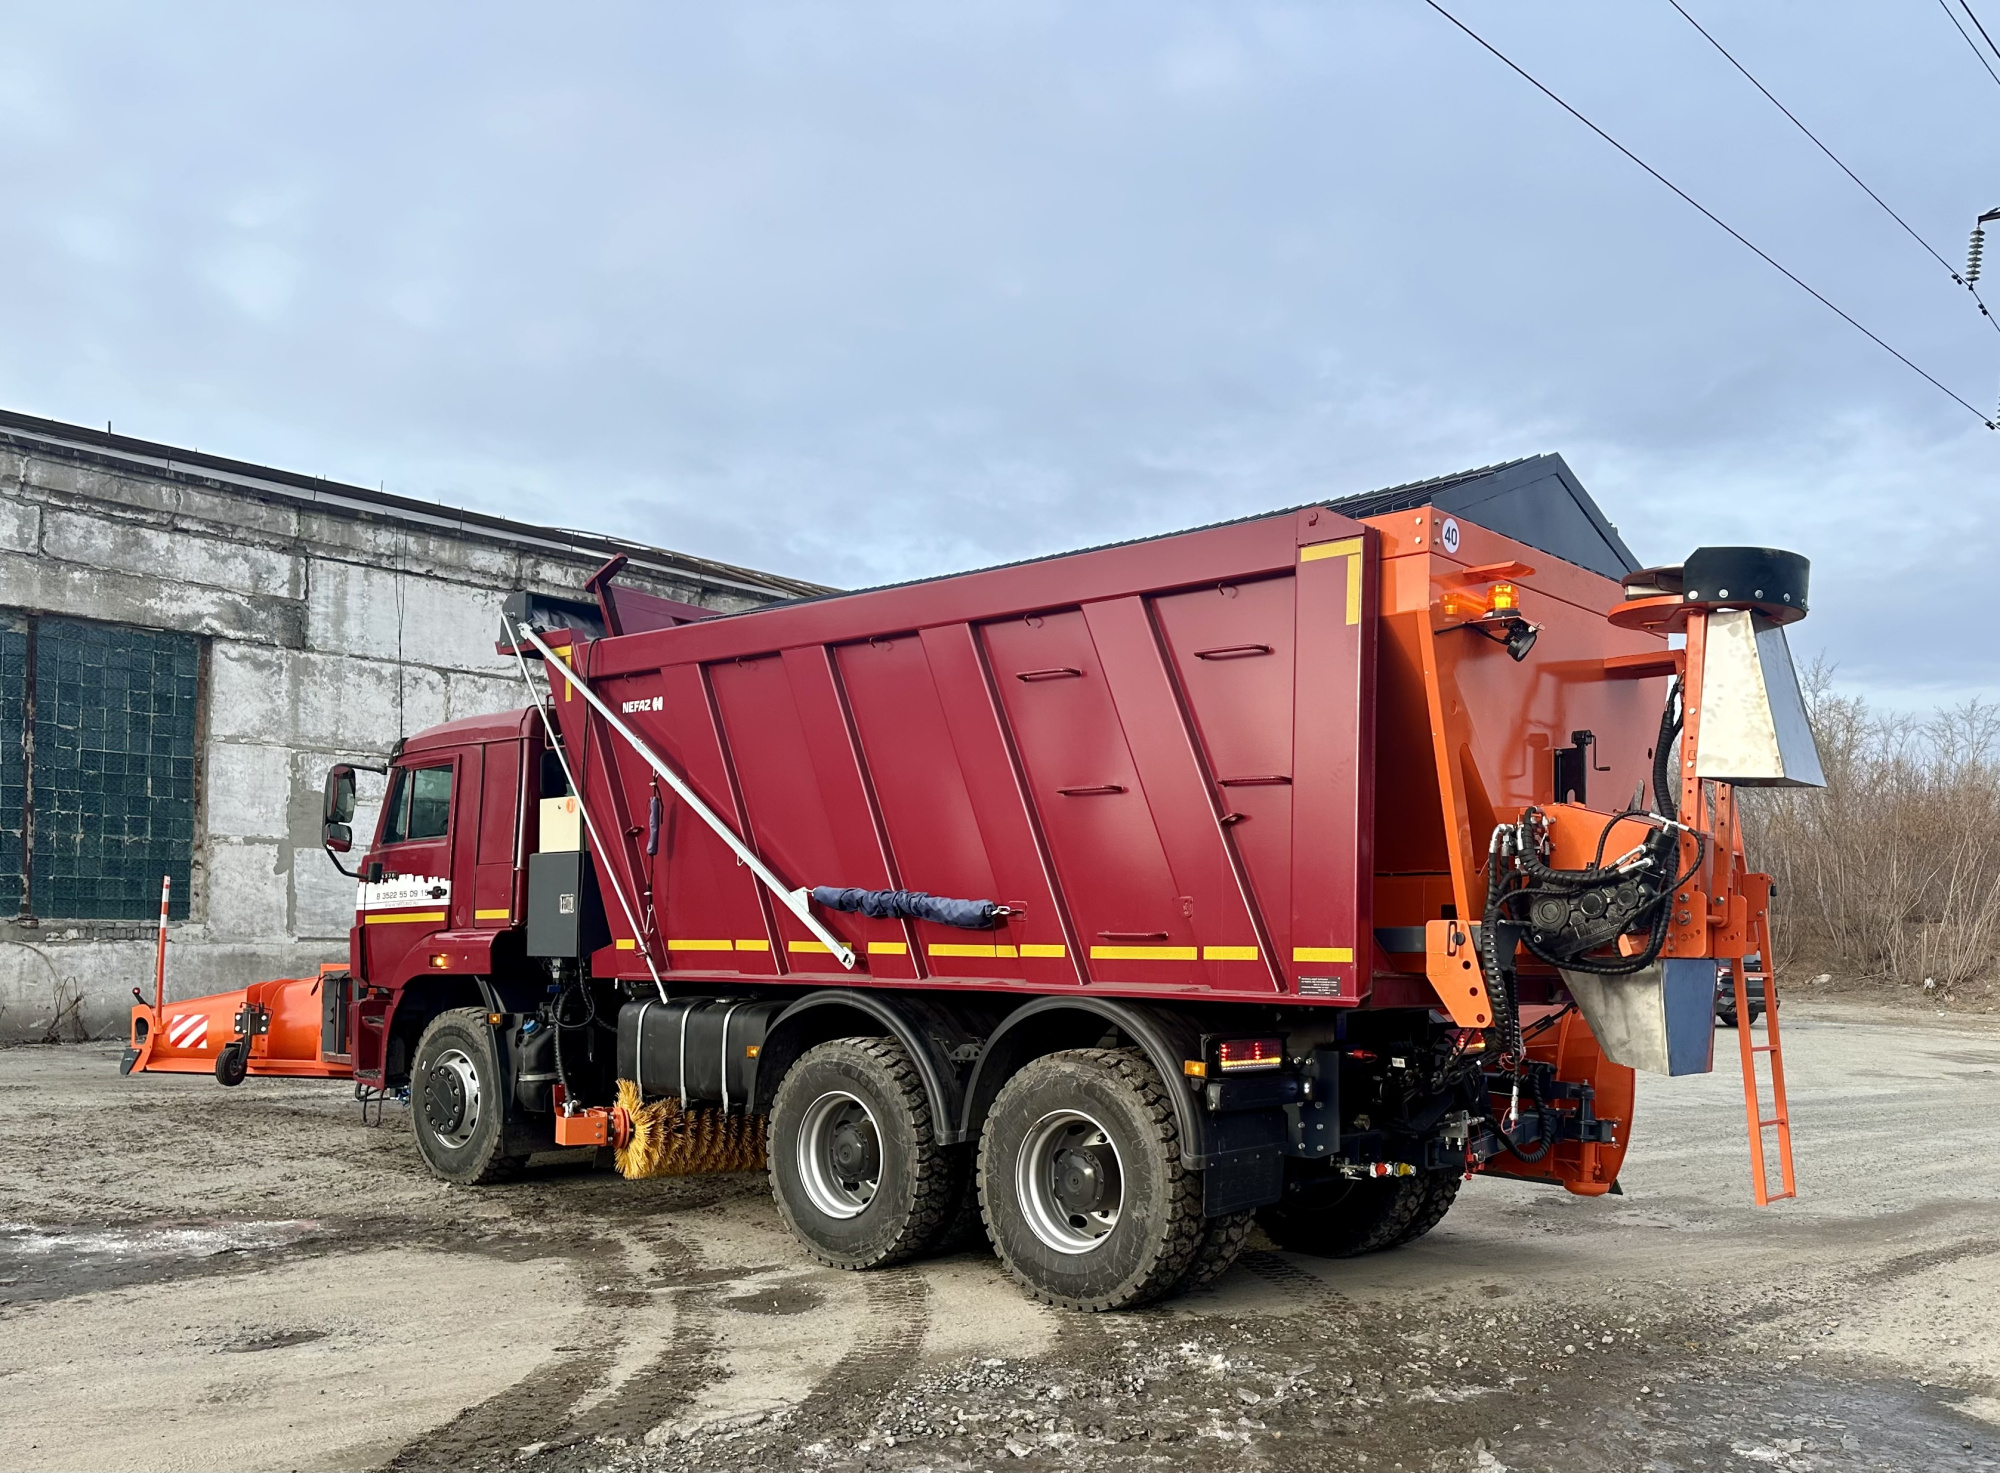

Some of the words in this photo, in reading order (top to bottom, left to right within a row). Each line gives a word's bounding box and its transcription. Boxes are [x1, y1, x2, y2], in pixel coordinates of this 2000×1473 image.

[1444, 526, 1458, 546] 40
[622, 699, 651, 714] NEFAZ
[399, 890, 408, 898] 55
[409, 889, 418, 898] 09
